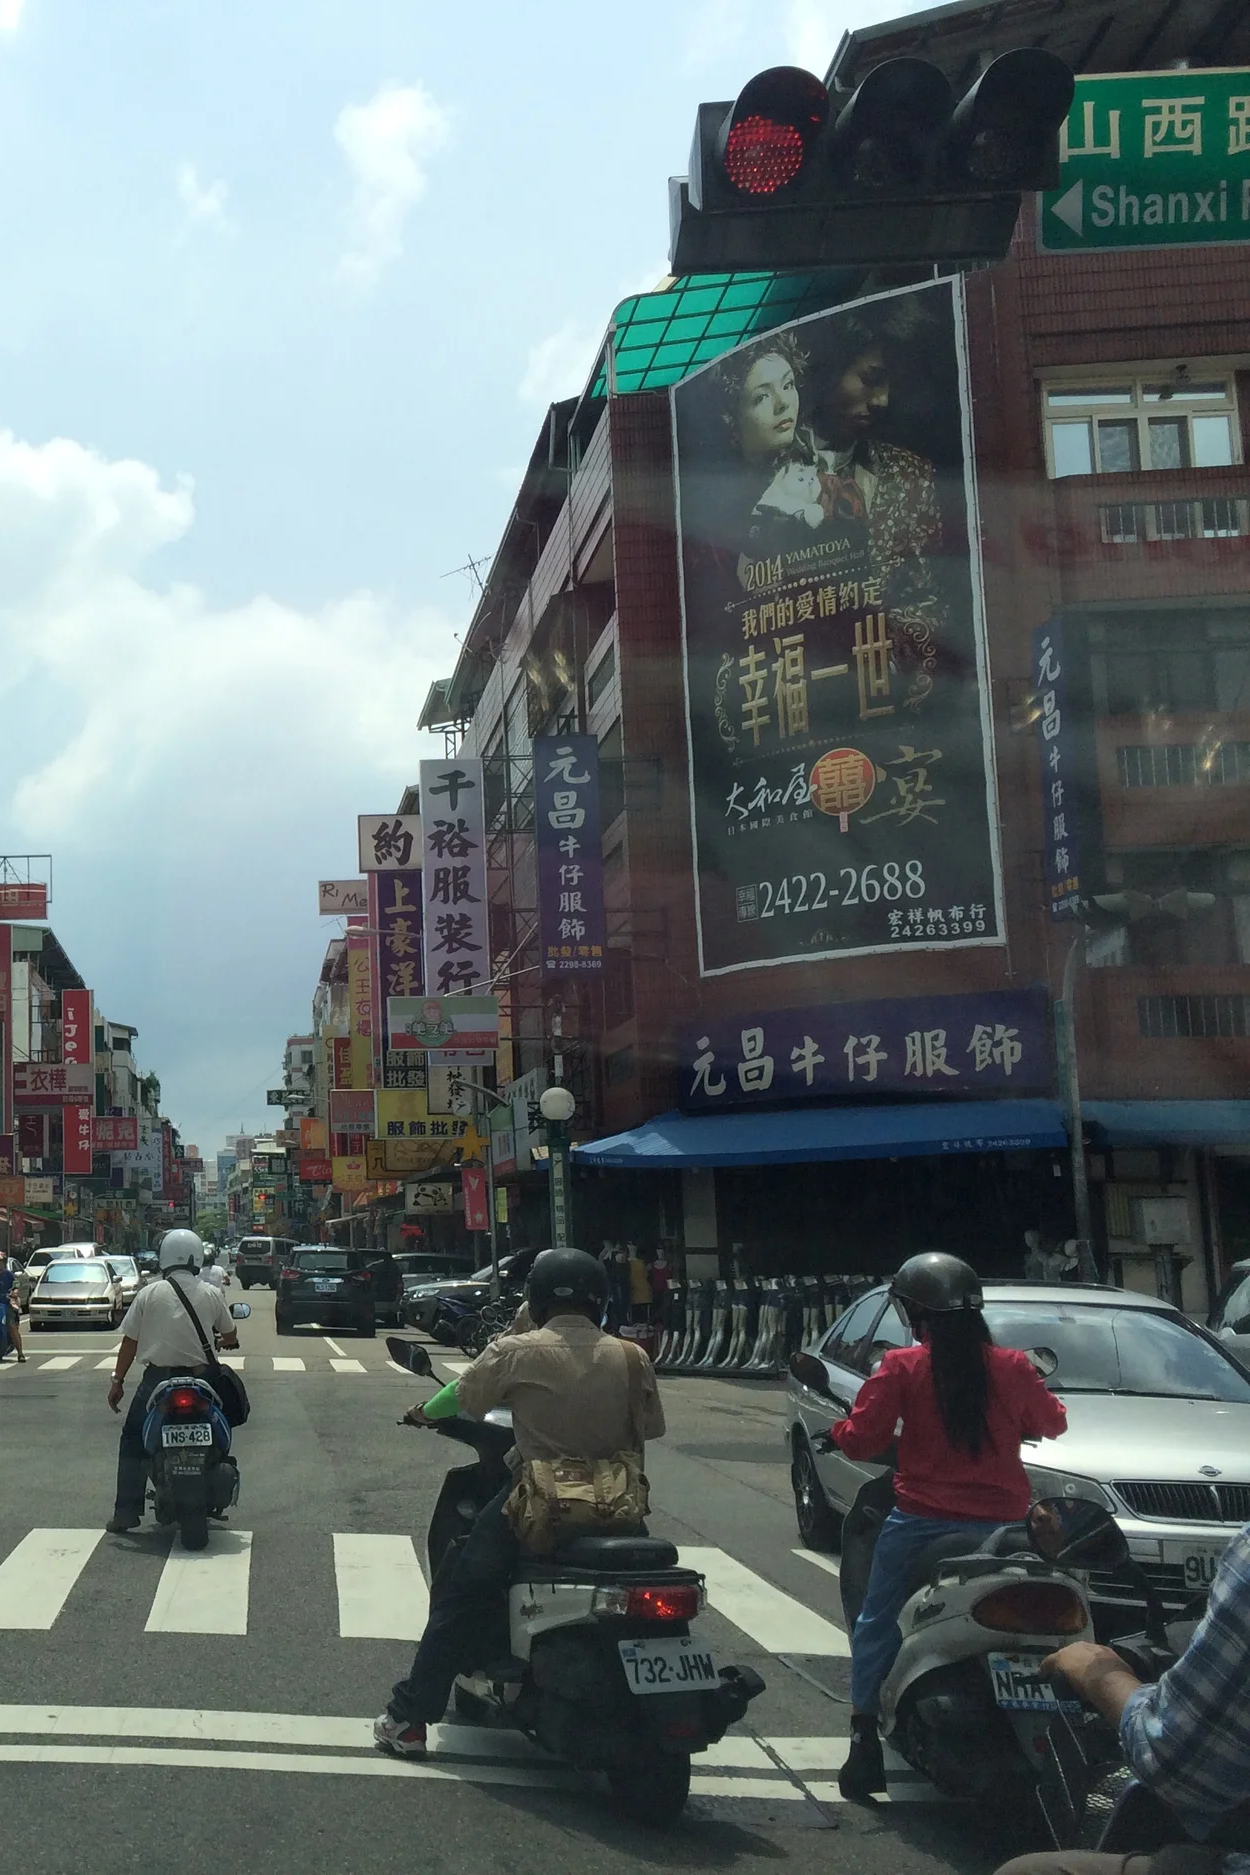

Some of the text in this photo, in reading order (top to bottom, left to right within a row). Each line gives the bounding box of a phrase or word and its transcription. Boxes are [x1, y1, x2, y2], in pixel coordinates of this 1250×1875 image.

[1091, 180, 1228, 228] Shanxi
[745, 537, 852, 592] 2014 YAMATOYA
[741, 576, 884, 640] 我們的愛情約定
[738, 612, 895, 747] 幸福一世
[372, 819, 414, 866] 約
[543, 746, 592, 942] 元昌牛仔服飾
[726, 808, 814, 836] 日本國際美食館
[427, 770, 483, 997] 千裕服裝行
[759, 859, 927, 919] 2422-2688
[887, 903, 988, 925] 宏祥帆布行
[890, 920, 987, 938] 24263399
[386, 1069, 427, 1087] 批發
[689, 1023, 1023, 1097] 元昌牛仔服飾
[386, 1119, 469, 1136] 服飾批發
